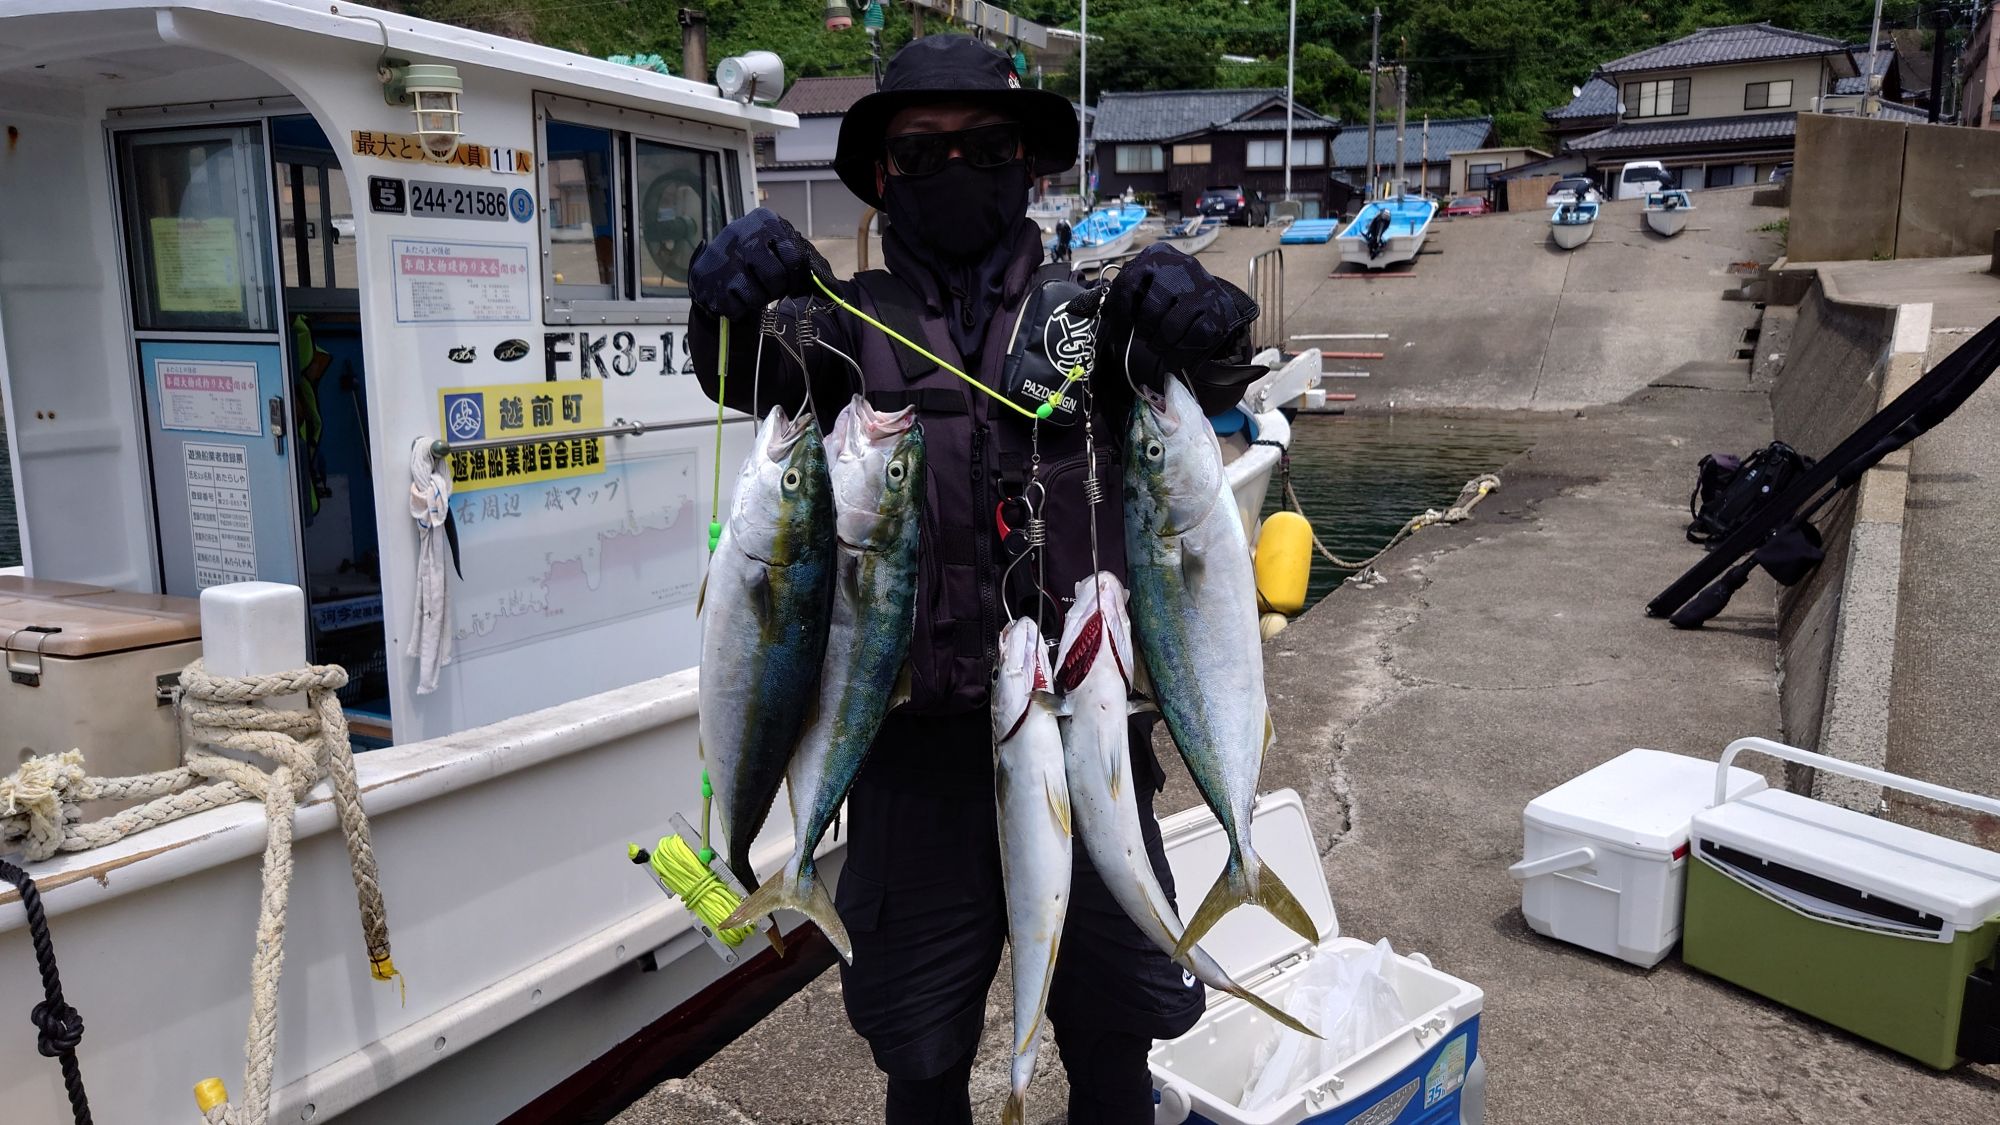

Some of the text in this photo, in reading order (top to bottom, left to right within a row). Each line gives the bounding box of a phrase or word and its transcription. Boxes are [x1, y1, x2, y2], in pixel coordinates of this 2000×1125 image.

[379, 188, 397, 206] 5
[411, 185, 507, 217] 244-21586
[517, 198, 525, 212] 9
[1022, 379, 1077, 411] PAZDIGN
[499, 393, 584, 431] 越前町
[451, 436, 600, 483] 遊漁船業組合会員証
[215, 472, 246, 484] あたらしや
